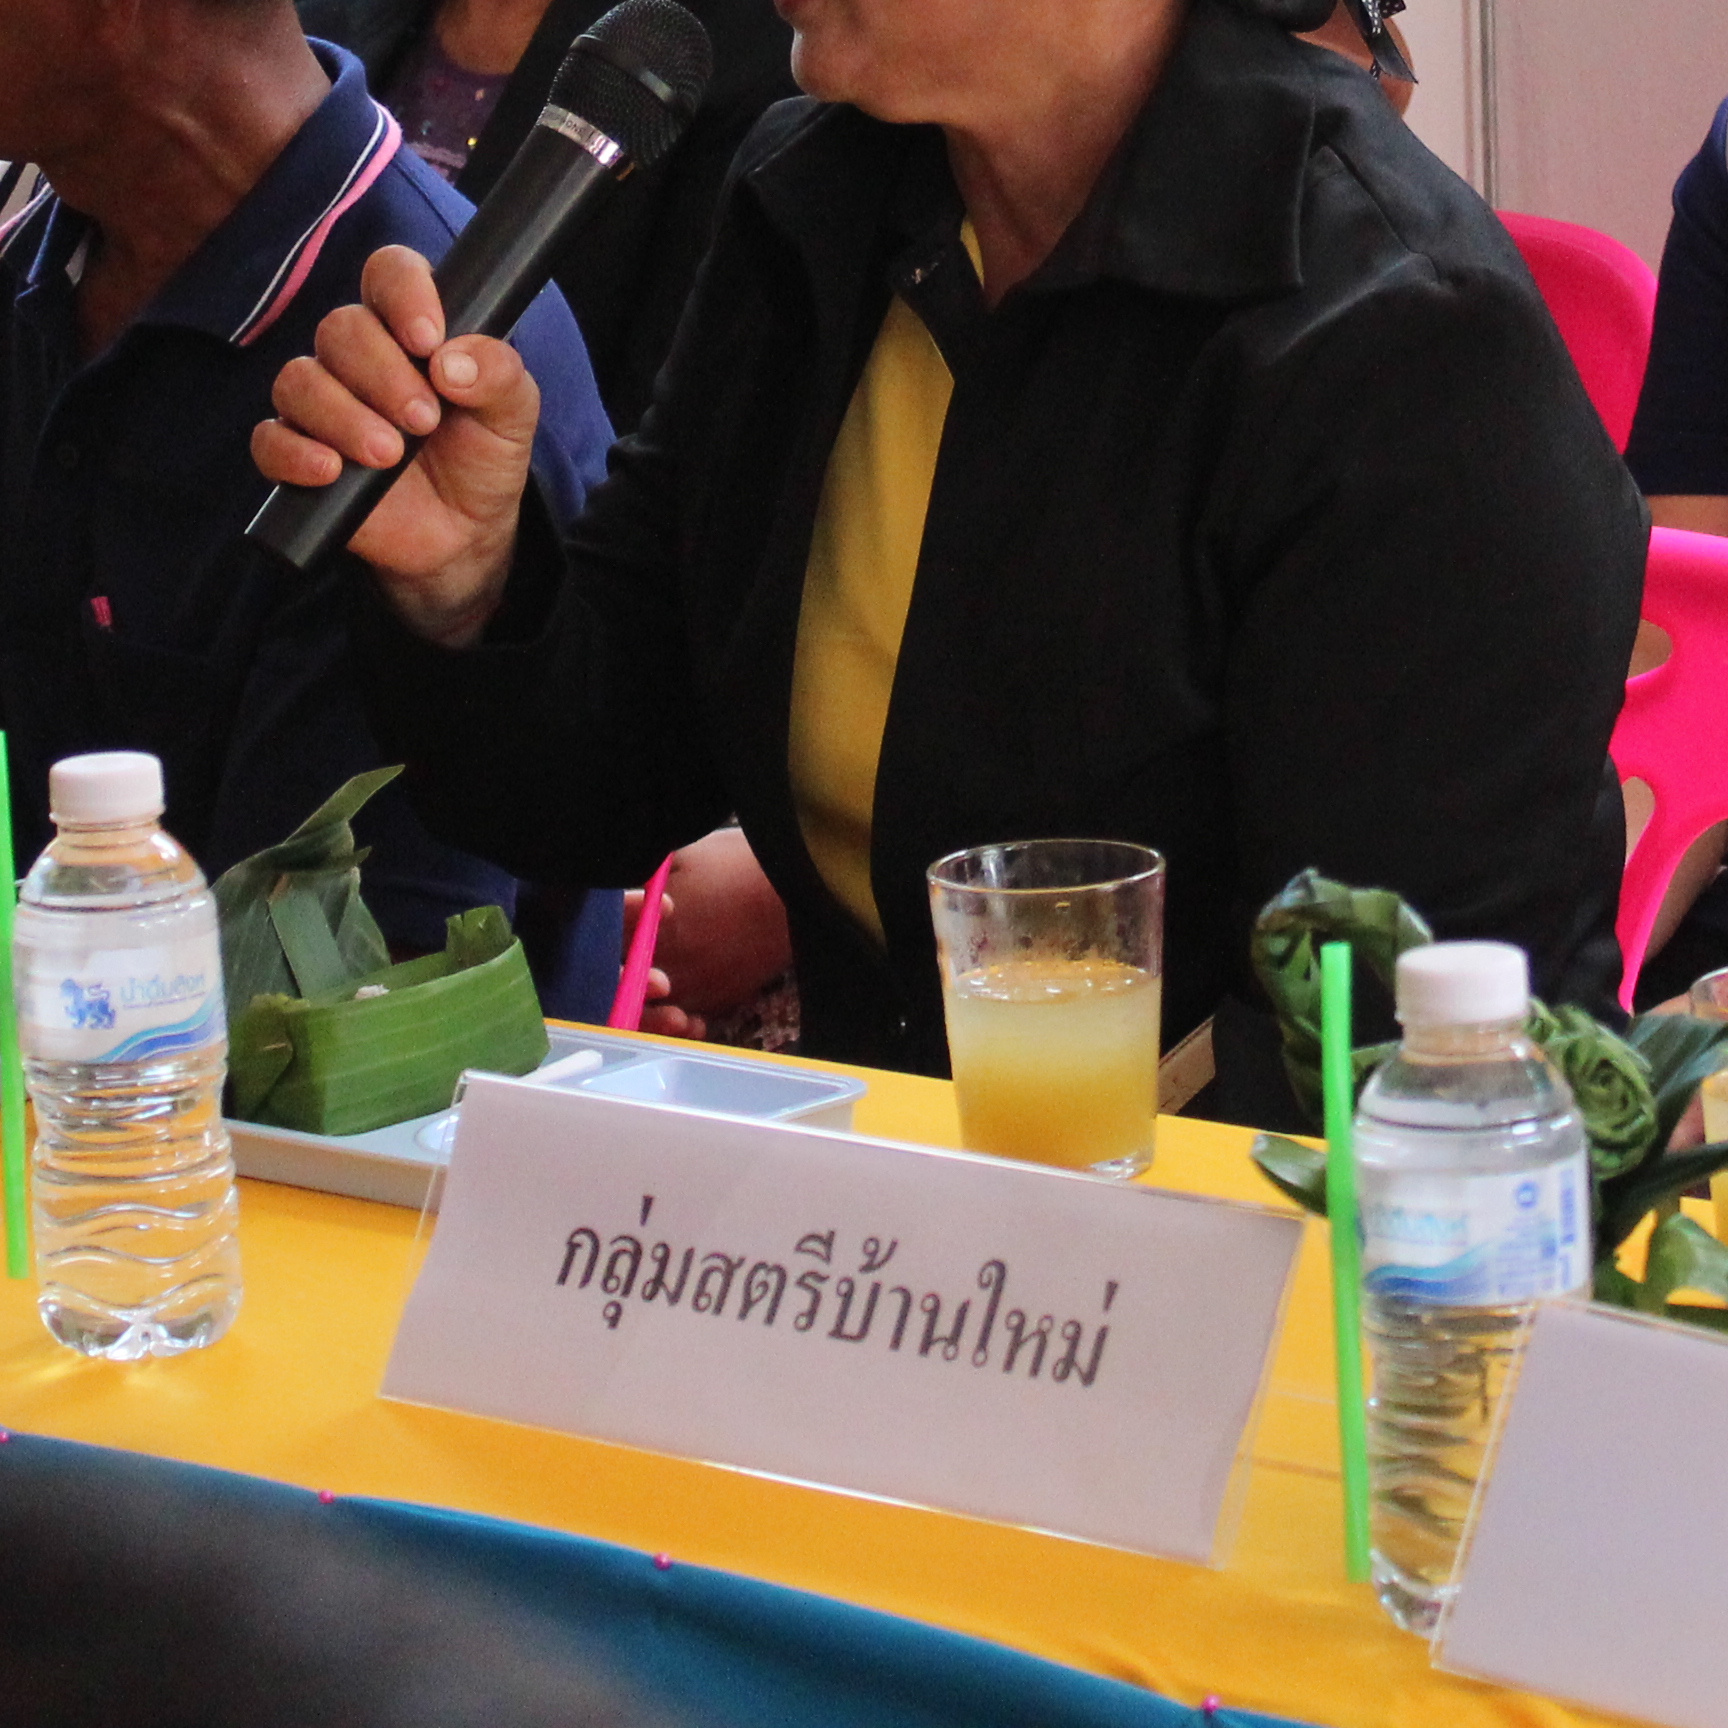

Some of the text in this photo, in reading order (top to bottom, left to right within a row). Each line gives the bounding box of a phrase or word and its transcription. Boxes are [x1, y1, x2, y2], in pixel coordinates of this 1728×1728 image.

[557, 1195, 1118, 1386] กลุ่มสตรีบ้านใหม่
